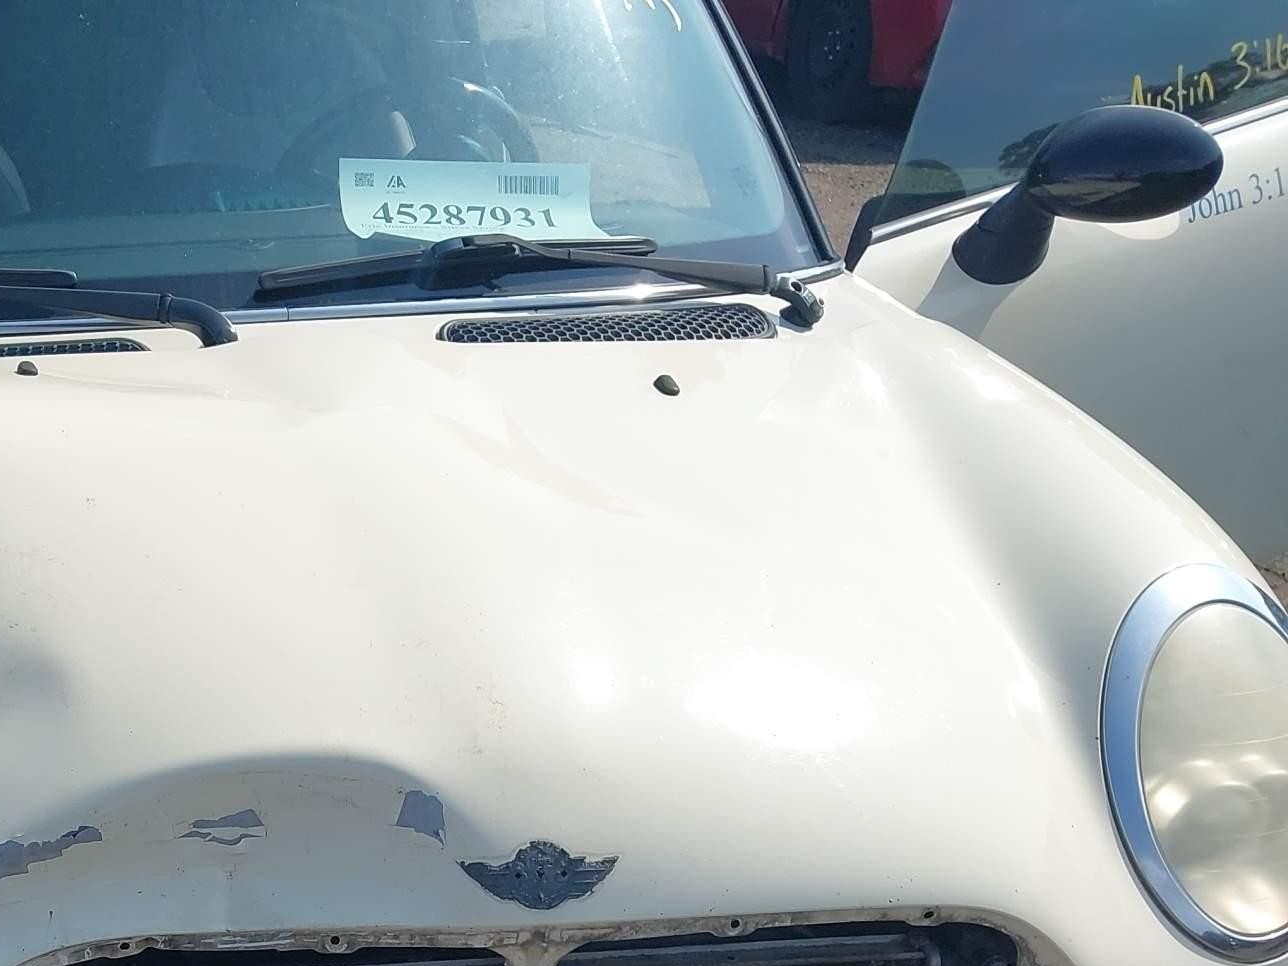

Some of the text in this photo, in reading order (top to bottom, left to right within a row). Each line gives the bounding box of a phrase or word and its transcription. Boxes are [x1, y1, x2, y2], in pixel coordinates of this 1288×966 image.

[1130, 64, 1215, 113] Austin
[372, 201, 558, 228] 45287931
[1187, 186, 1243, 224] John
